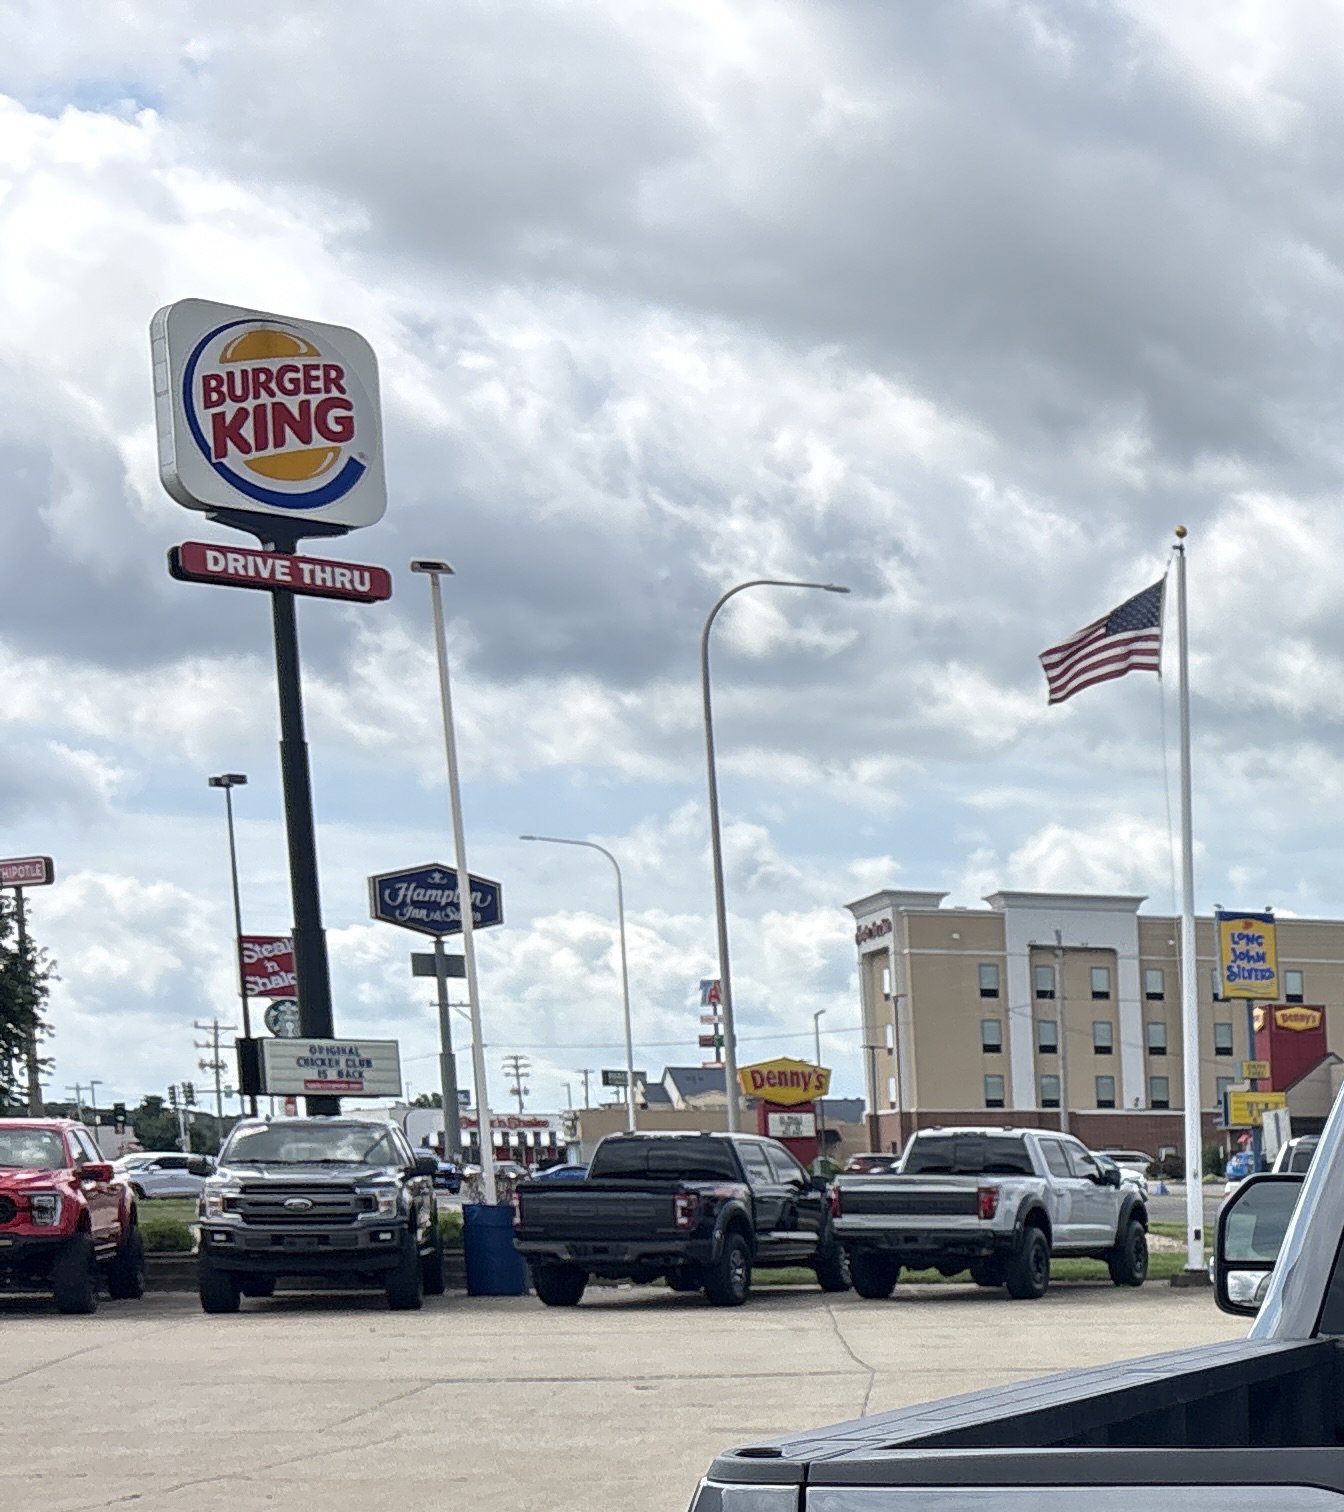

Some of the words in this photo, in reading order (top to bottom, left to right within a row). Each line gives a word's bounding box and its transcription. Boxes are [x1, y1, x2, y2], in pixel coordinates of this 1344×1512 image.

[202, 363, 347, 410] BURGER
[211, 396, 355, 460] KING
[205, 549, 293, 582] DRIVE
[297, 562, 371, 593] THRU
[0, 863, 42, 879] HIPOTLE
[750, 1068, 826, 1092] Denny's
